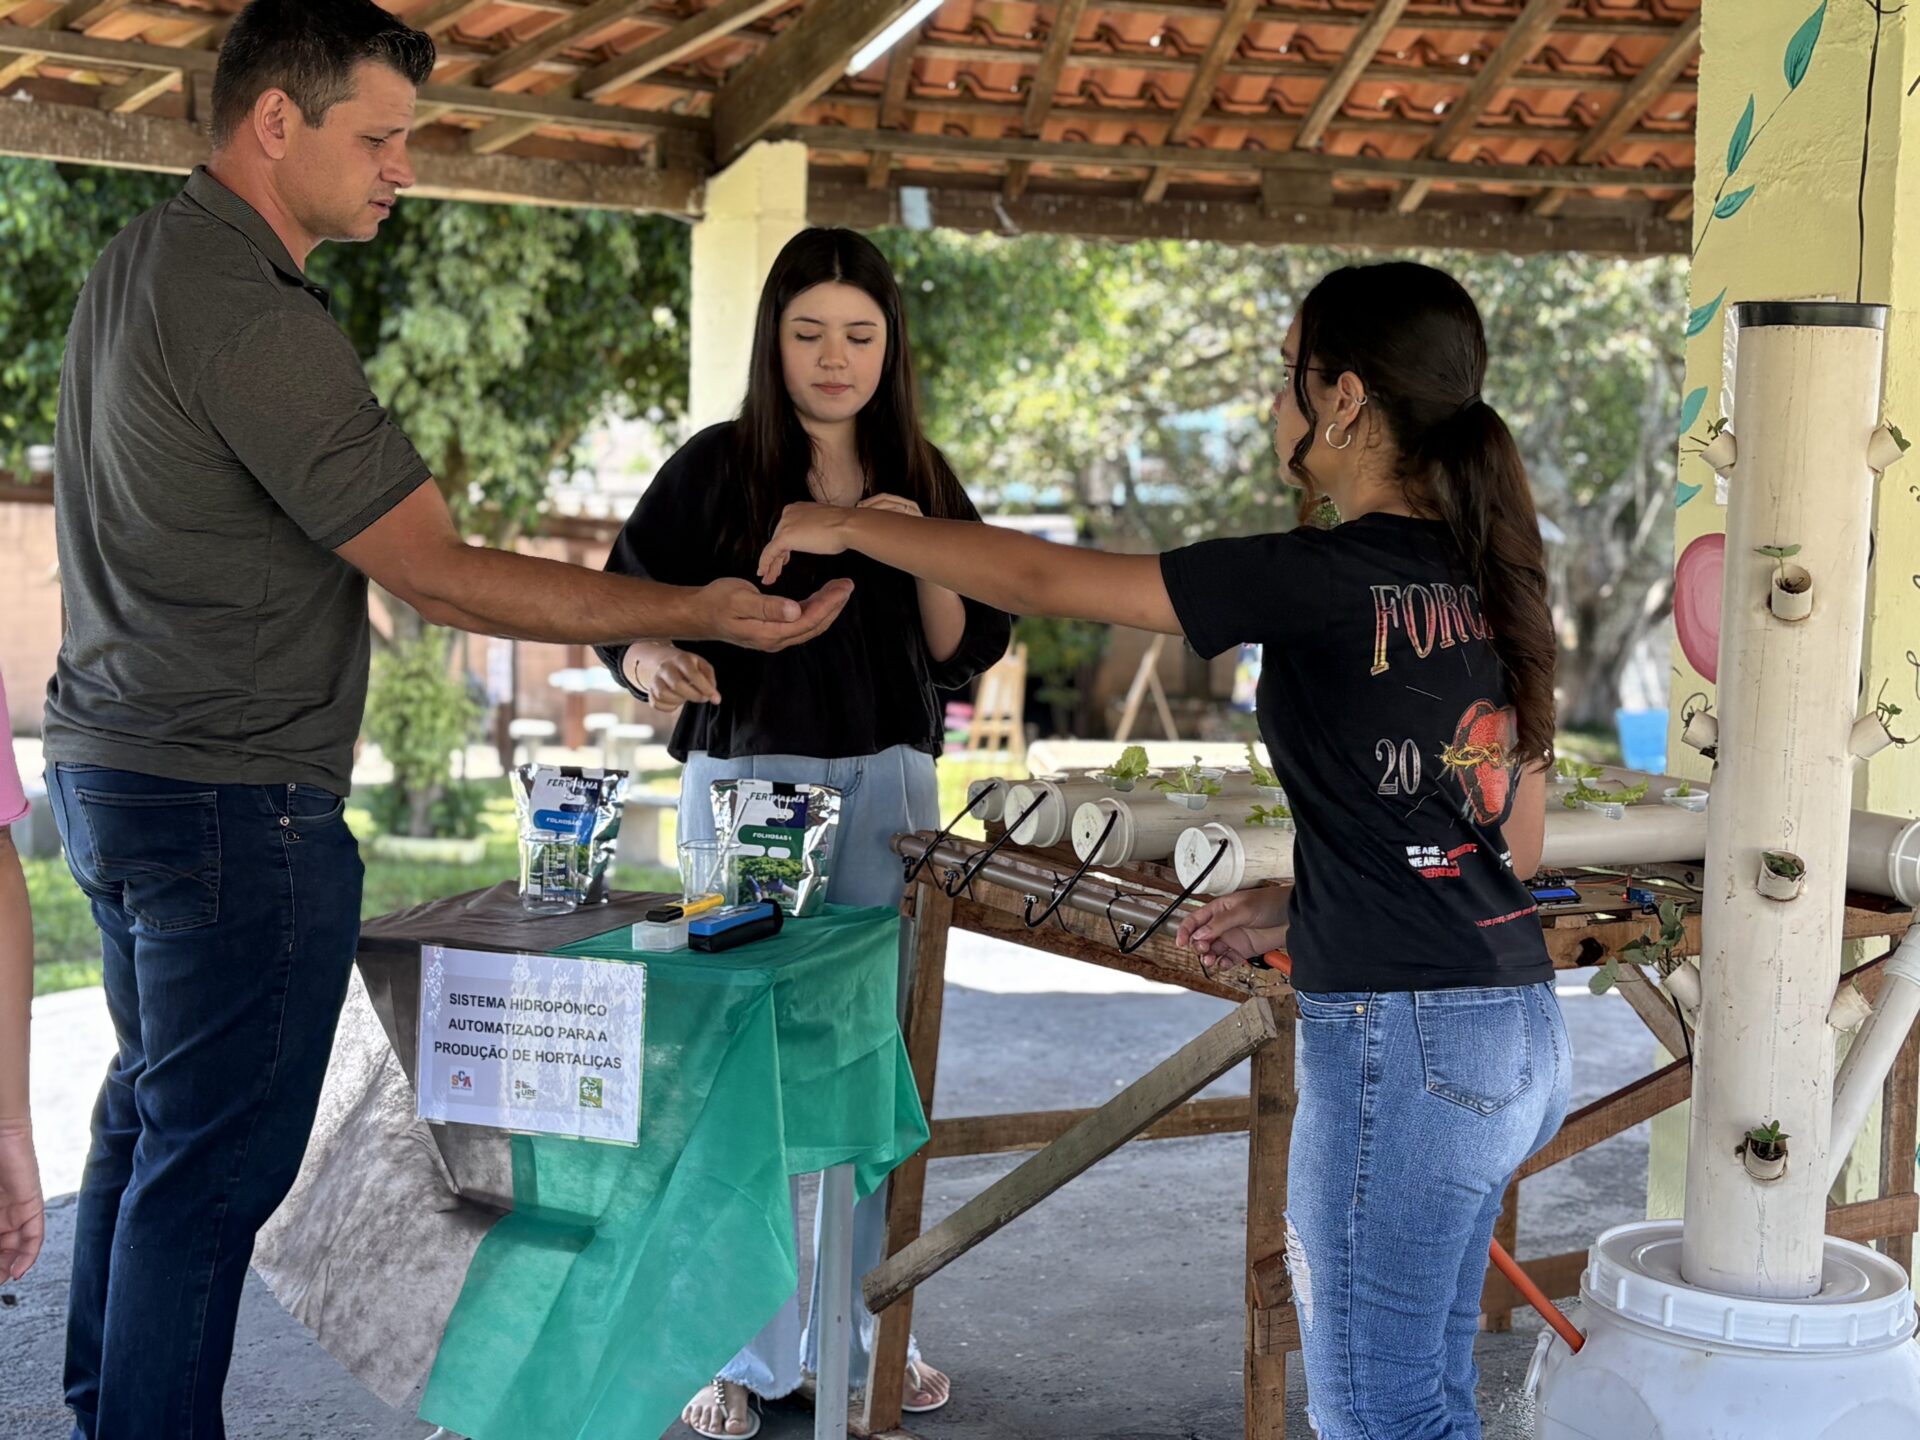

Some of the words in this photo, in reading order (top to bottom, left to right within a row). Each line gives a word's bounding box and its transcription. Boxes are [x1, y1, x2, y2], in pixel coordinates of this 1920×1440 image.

[1370, 583, 1494, 676] FORC
[1375, 738, 1421, 795] 20
[752, 832, 788, 841] FOLHOSAS
[1405, 845, 1421, 856] WE
[1422, 845, 1440, 856] ARE
[1408, 858, 1423, 868] WE
[1423, 857, 1441, 867] ARE
[1441, 857, 1449, 867] A
[449, 993, 506, 1009] SISTEMA
[510, 998, 608, 1017] HIDROPÔNICO
[448, 1018, 554, 1038] AUTOMATIZADO
[558, 1026, 596, 1042] PARA
[598, 1031, 608, 1043] A
[434, 1041, 508, 1060] PRODUÇÃO
[512, 1048, 531, 1062] DE
[535, 1050, 622, 1071] HORTALIÇAS
